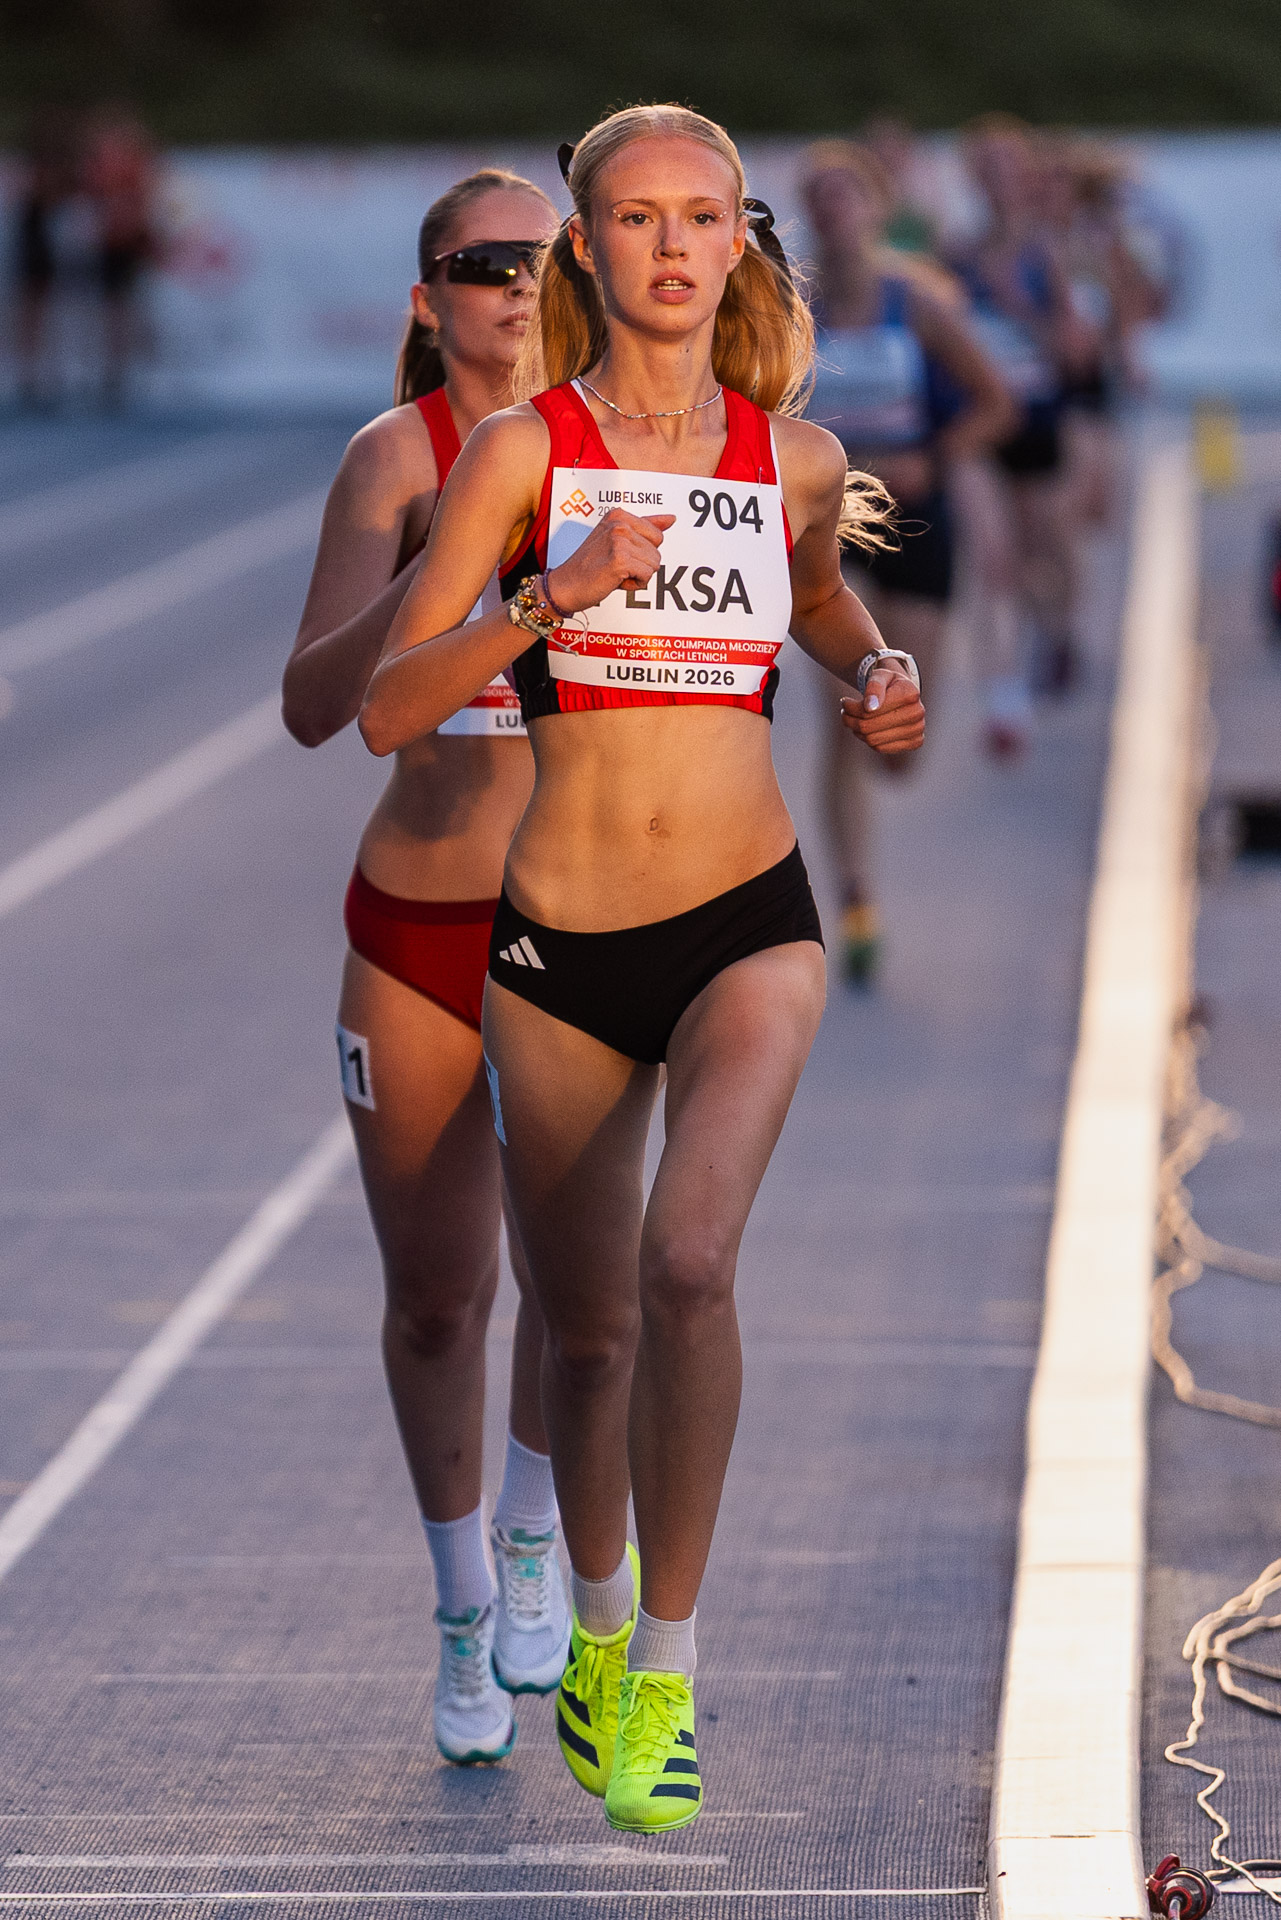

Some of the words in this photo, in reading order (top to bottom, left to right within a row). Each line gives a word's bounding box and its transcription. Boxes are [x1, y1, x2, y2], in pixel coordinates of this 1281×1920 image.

[598, 490, 663, 505] LUBELSKIE
[598, 506, 616, 517] 20
[688, 489, 764, 534] 904
[592, 564, 753, 614] EKSA
[560, 631, 585, 643] XXX
[587, 634, 672, 648] OGÓLNOPOLSKA
[673, 639, 727, 651] OLIMPIADA
[729, 642, 777, 654] MŁODZIEŻY
[616, 648, 627, 657] W
[629, 649, 685, 660] SPORTACH
[687, 651, 727, 662] LETNICH
[606, 665, 679, 684] LUBLIN
[684, 668, 735, 686] 2026
